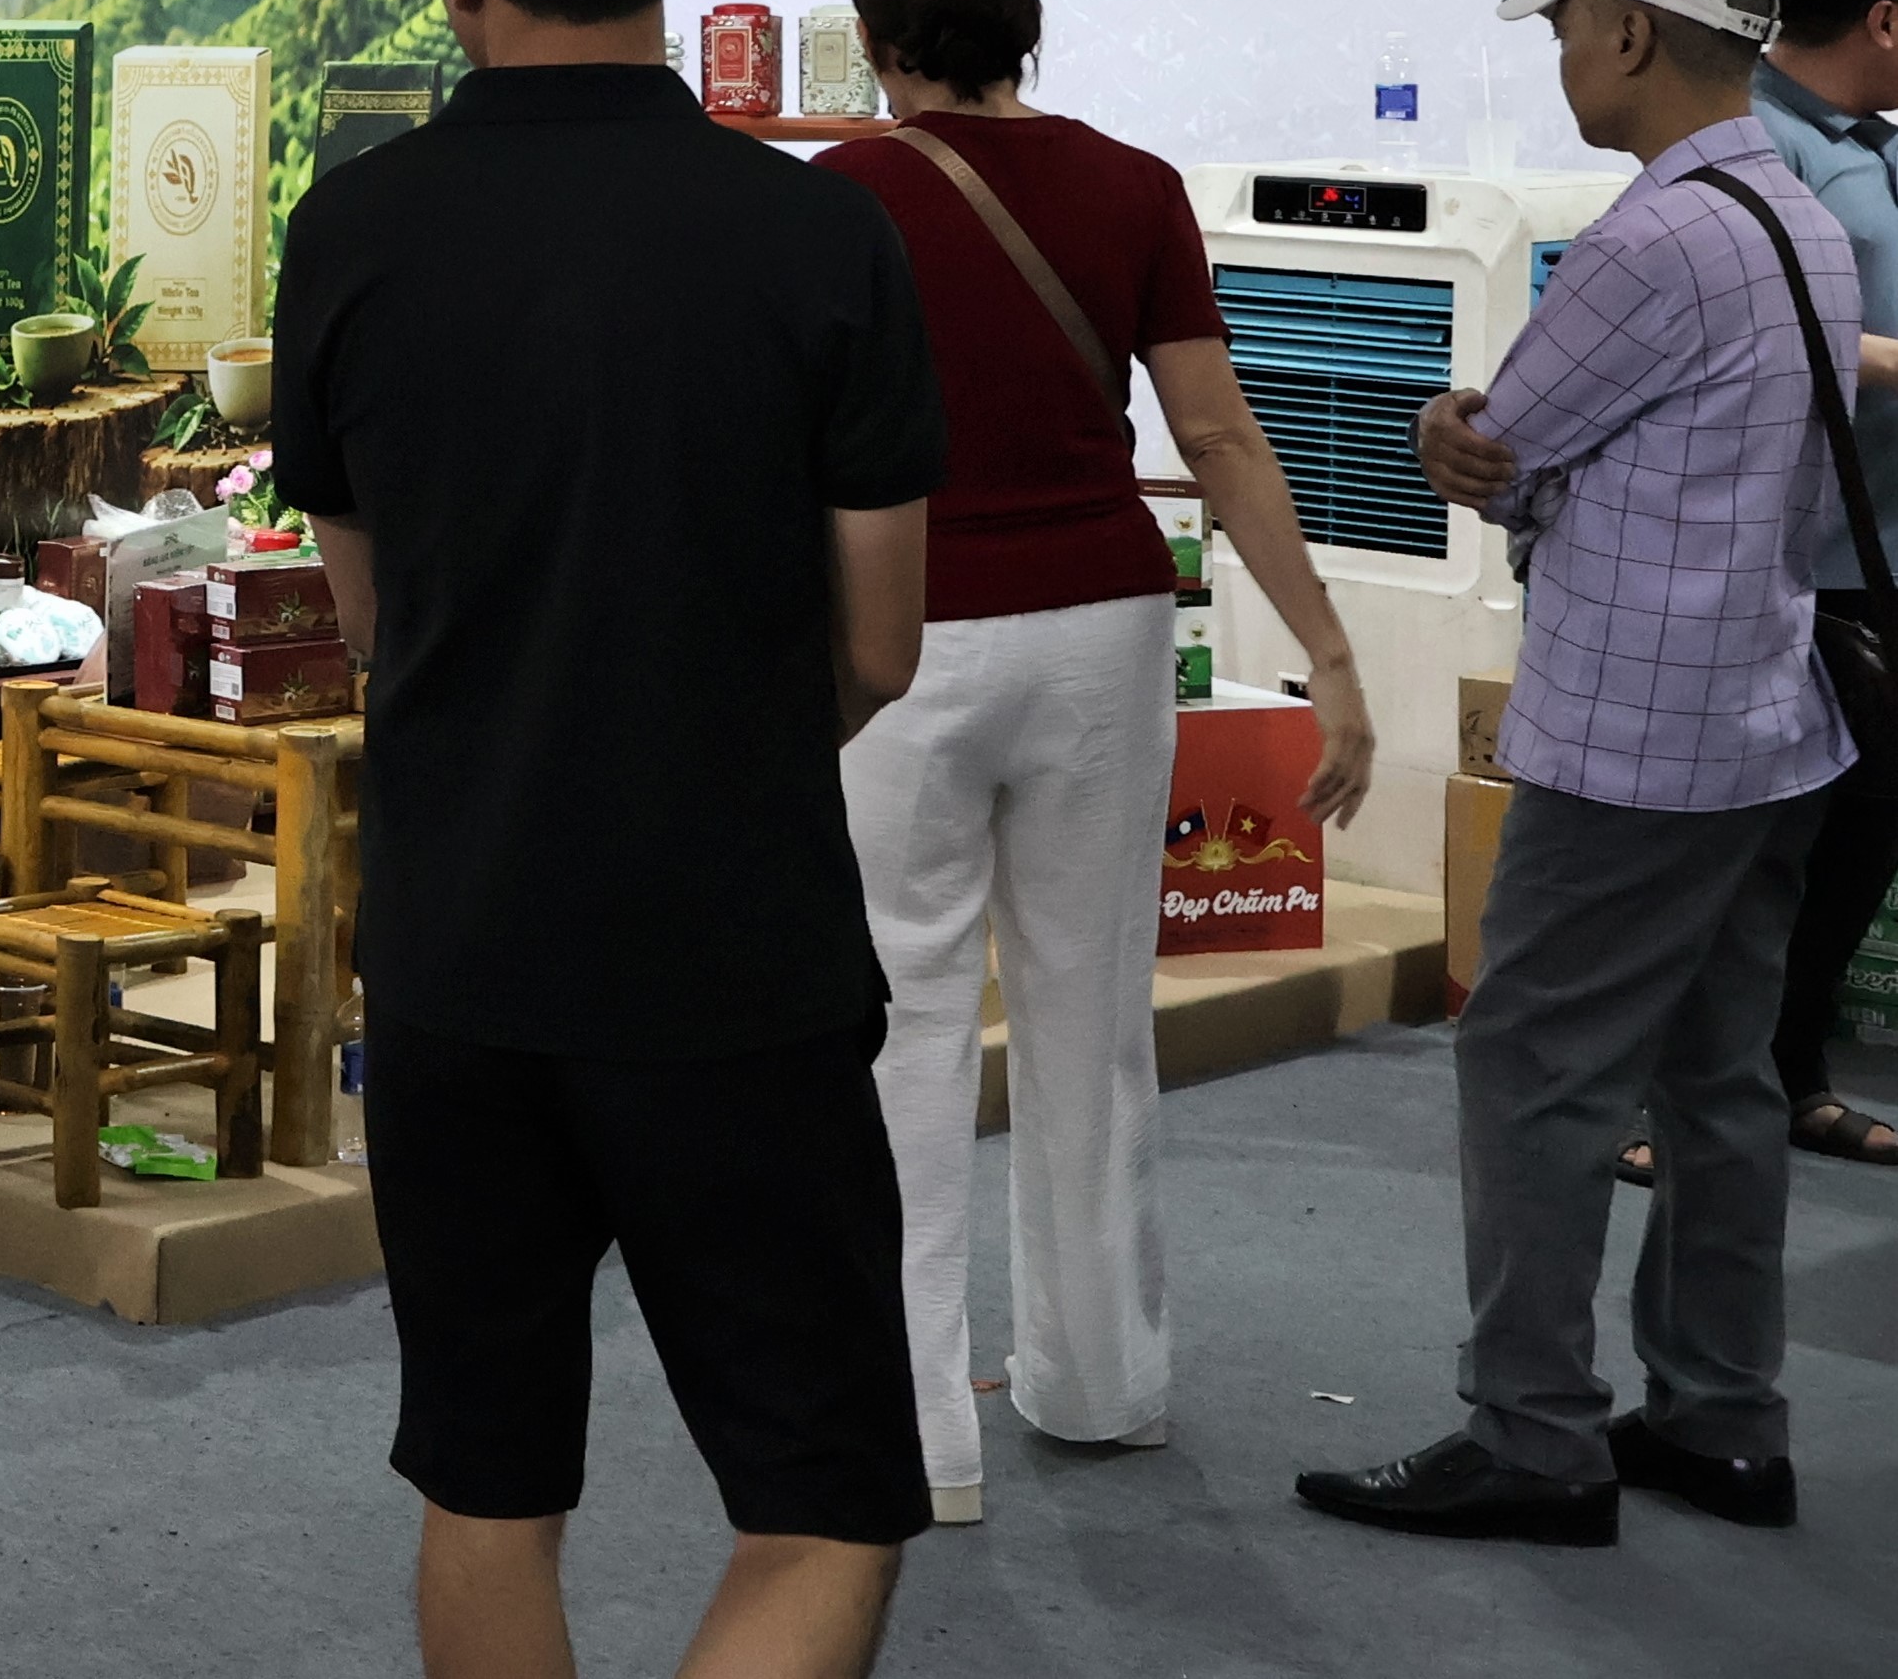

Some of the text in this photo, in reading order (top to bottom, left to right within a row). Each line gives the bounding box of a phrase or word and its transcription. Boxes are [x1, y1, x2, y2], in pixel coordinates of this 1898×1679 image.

[1162, 885, 1320, 923] Đẹp Chăm Pa
